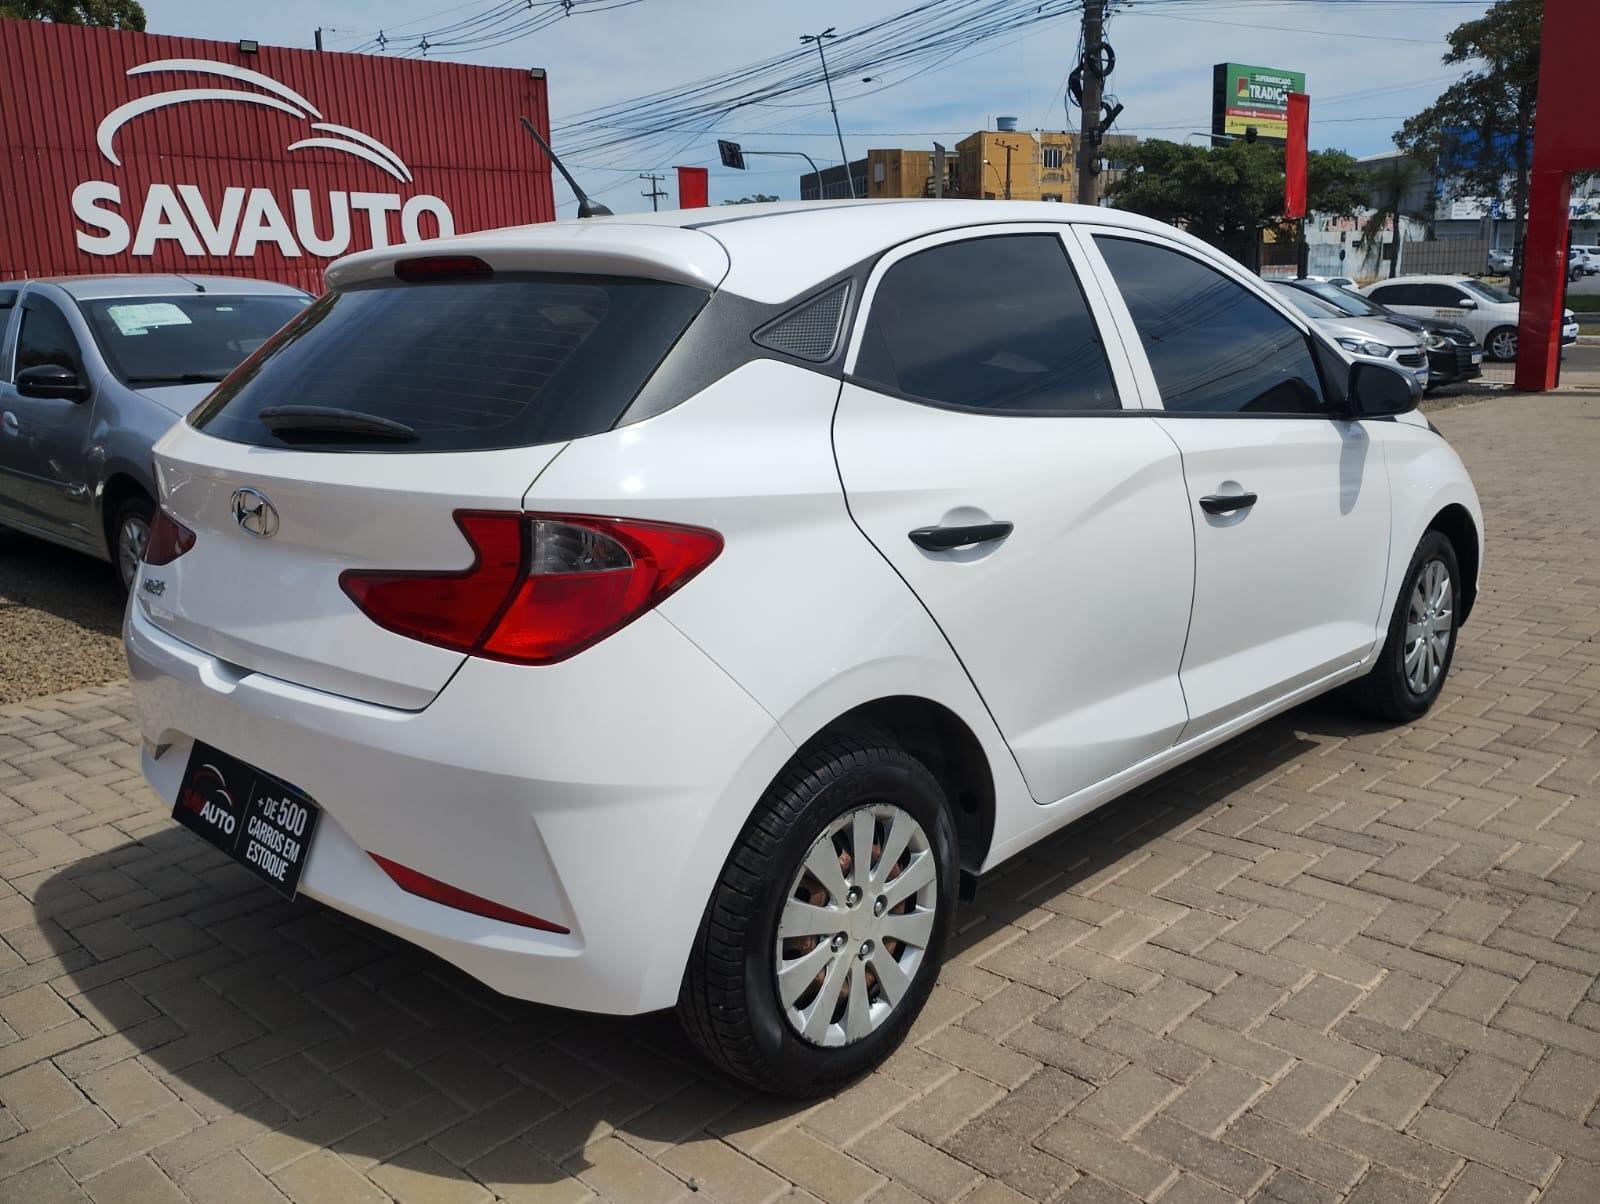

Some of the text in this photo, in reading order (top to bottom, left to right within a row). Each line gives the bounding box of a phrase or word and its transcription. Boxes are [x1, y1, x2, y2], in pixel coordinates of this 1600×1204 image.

[1250, 85, 1294, 104] TRADIÇÃ
[71, 180, 455, 257] SAVAUTO
[263, 797, 279, 820] DE
[277, 798, 308, 836] 500
[247, 816, 300, 863] CARROS EM
[246, 840, 289, 882] ESTOQUE
